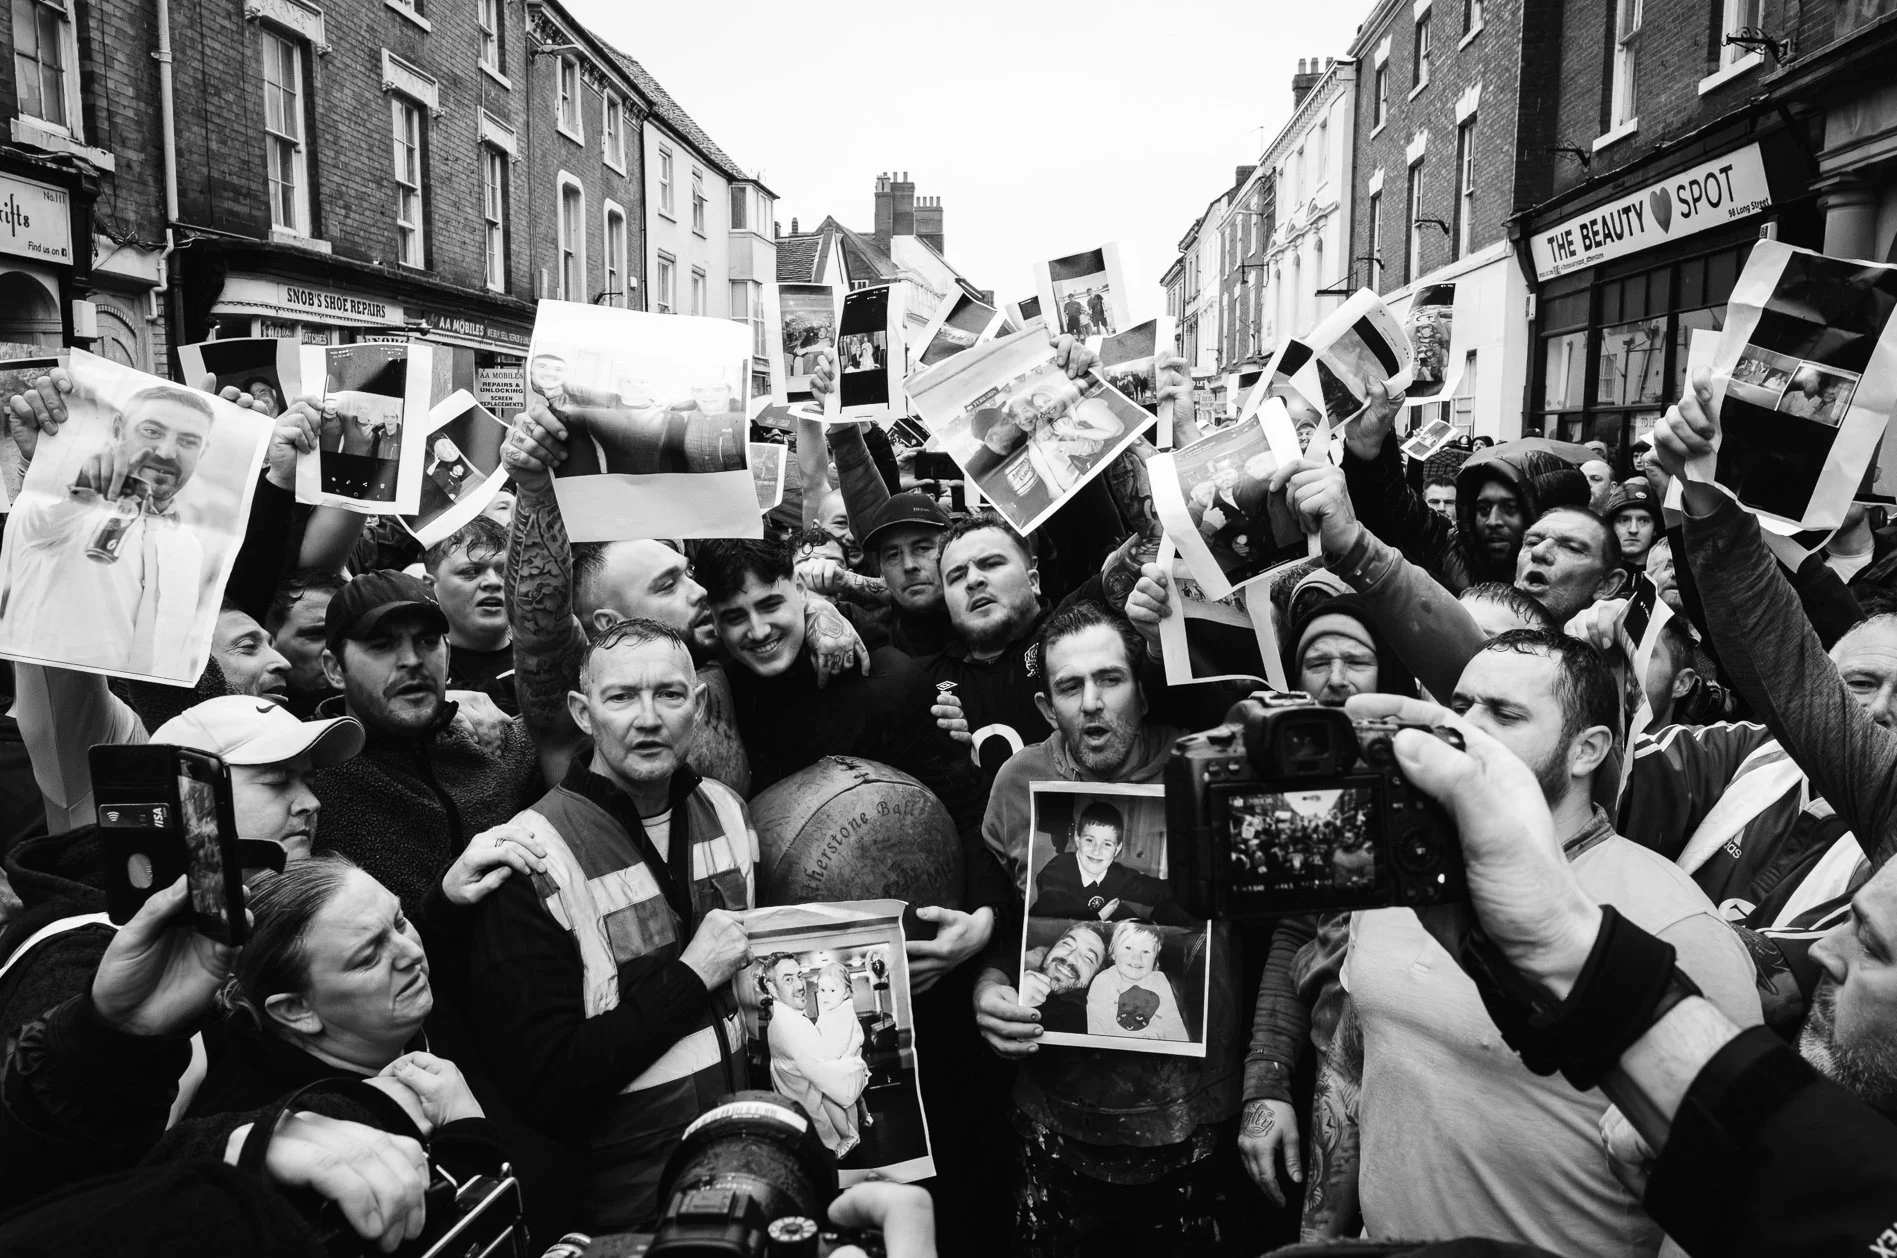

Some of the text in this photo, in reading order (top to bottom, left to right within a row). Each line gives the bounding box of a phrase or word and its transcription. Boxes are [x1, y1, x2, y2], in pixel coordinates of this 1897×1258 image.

[0, 193, 31, 238] ifts
[1547, 163, 1735, 263] THE BEAUTY SPOT
[1728, 196, 1770, 219] 98 Long Street
[28, 241, 60, 256] Find us on
[287, 287, 386, 319] SNOB'S SHOE REPAIRS
[439, 316, 451, 330] AA
[452, 318, 484, 337] MOBILES
[492, 372, 524, 380] MOBILES
[801, 812, 869, 893] therstone
